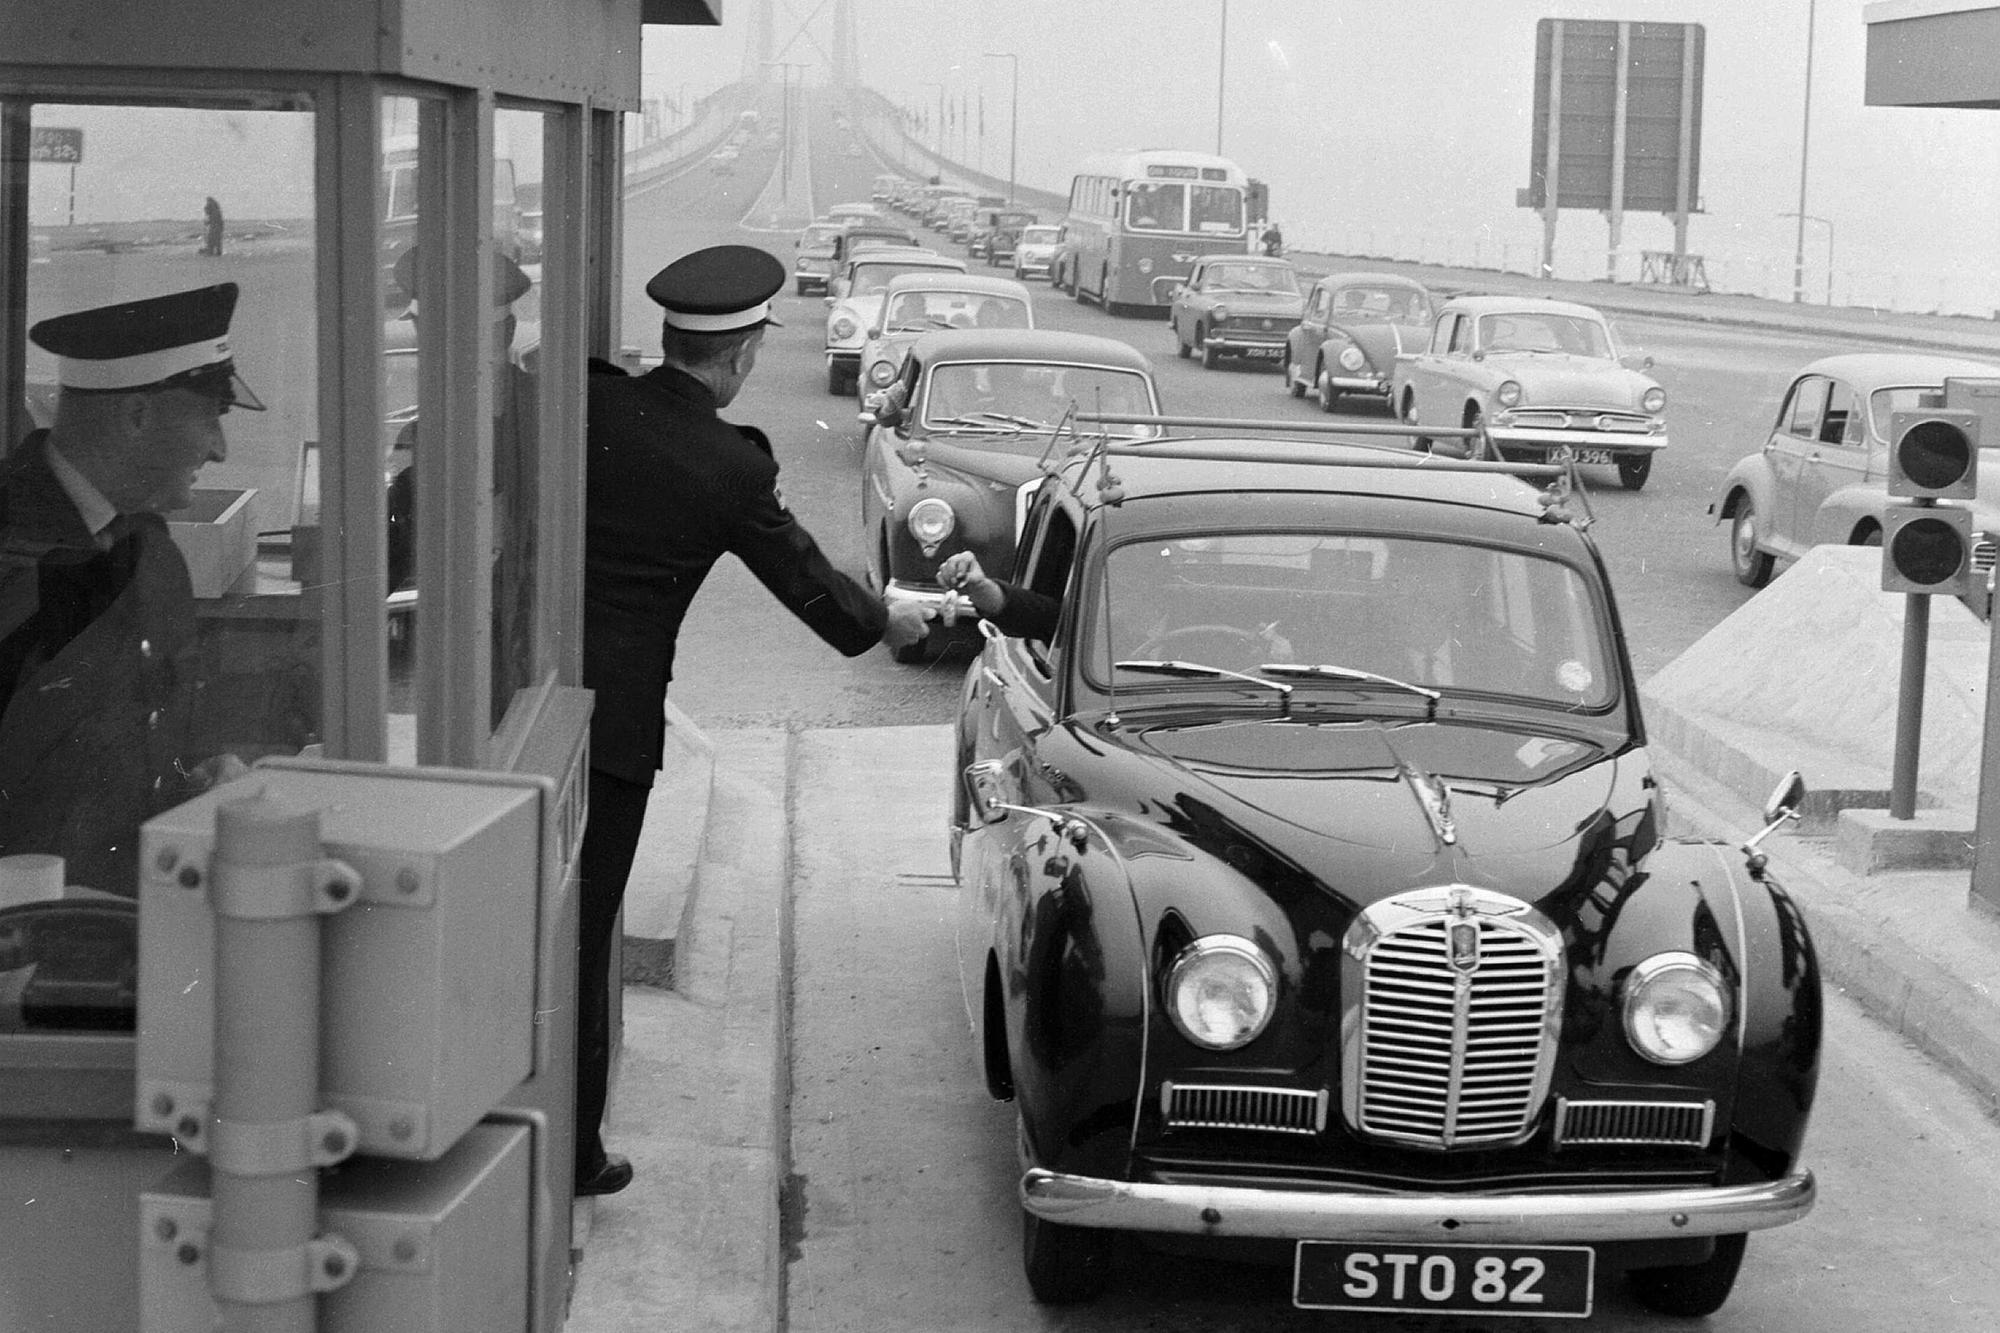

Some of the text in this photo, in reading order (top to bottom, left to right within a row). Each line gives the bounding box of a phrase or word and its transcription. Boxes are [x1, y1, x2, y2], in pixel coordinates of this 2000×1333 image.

[1581, 448, 1609, 464] 396
[1343, 1252, 1545, 1303] STO 82
